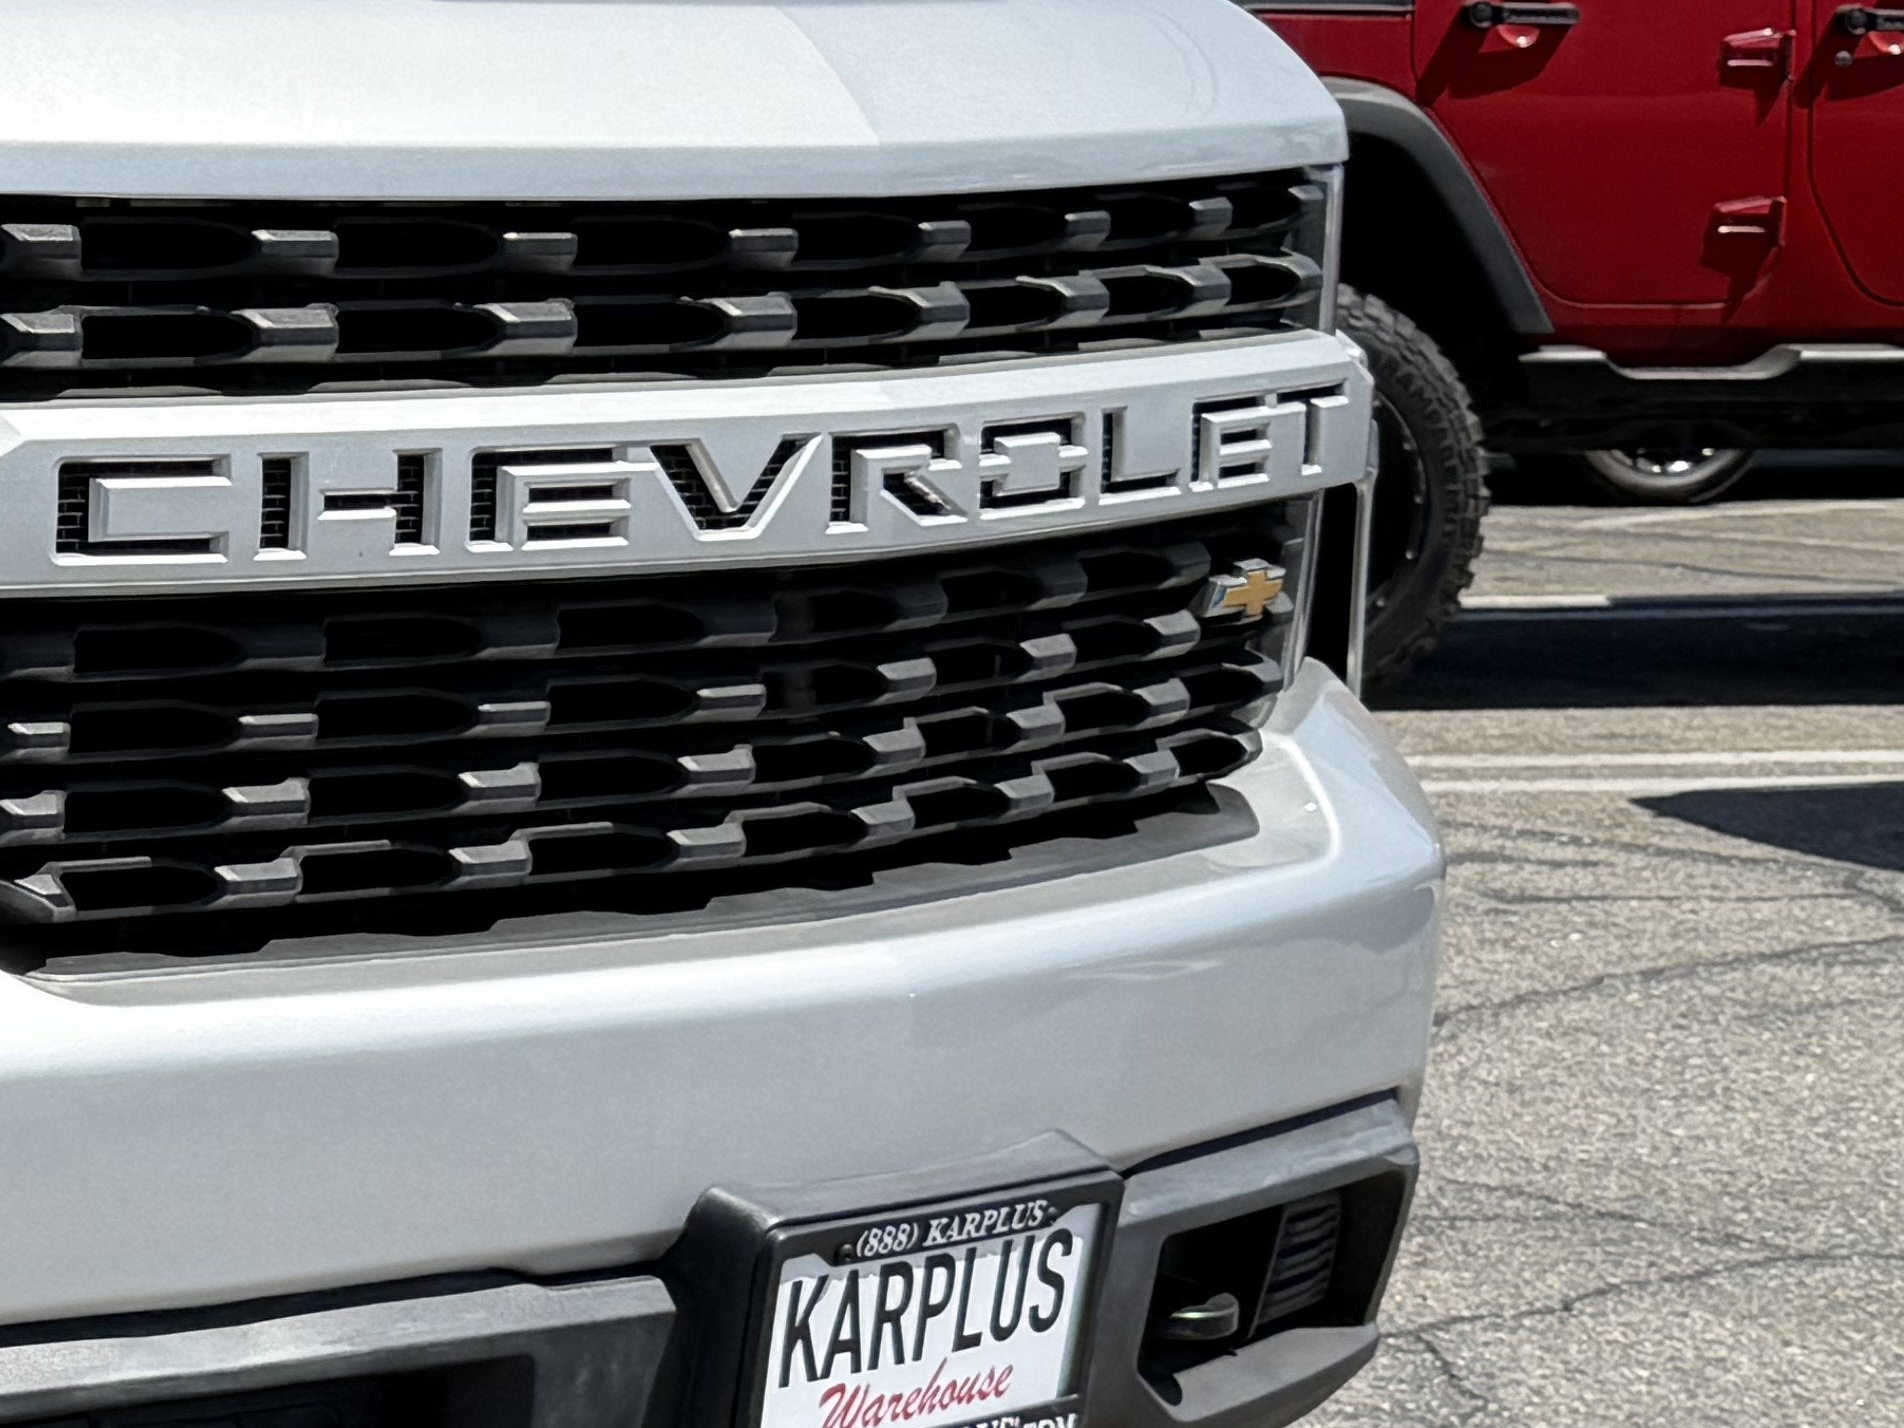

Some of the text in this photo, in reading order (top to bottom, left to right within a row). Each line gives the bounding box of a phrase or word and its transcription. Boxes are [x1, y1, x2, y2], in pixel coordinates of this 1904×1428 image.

[49, 380, 1354, 565] CHEVROLET
[777, 1228, 1075, 1389] KARPLUS
[855, 1199, 1048, 1258] (888) KARPLUS
